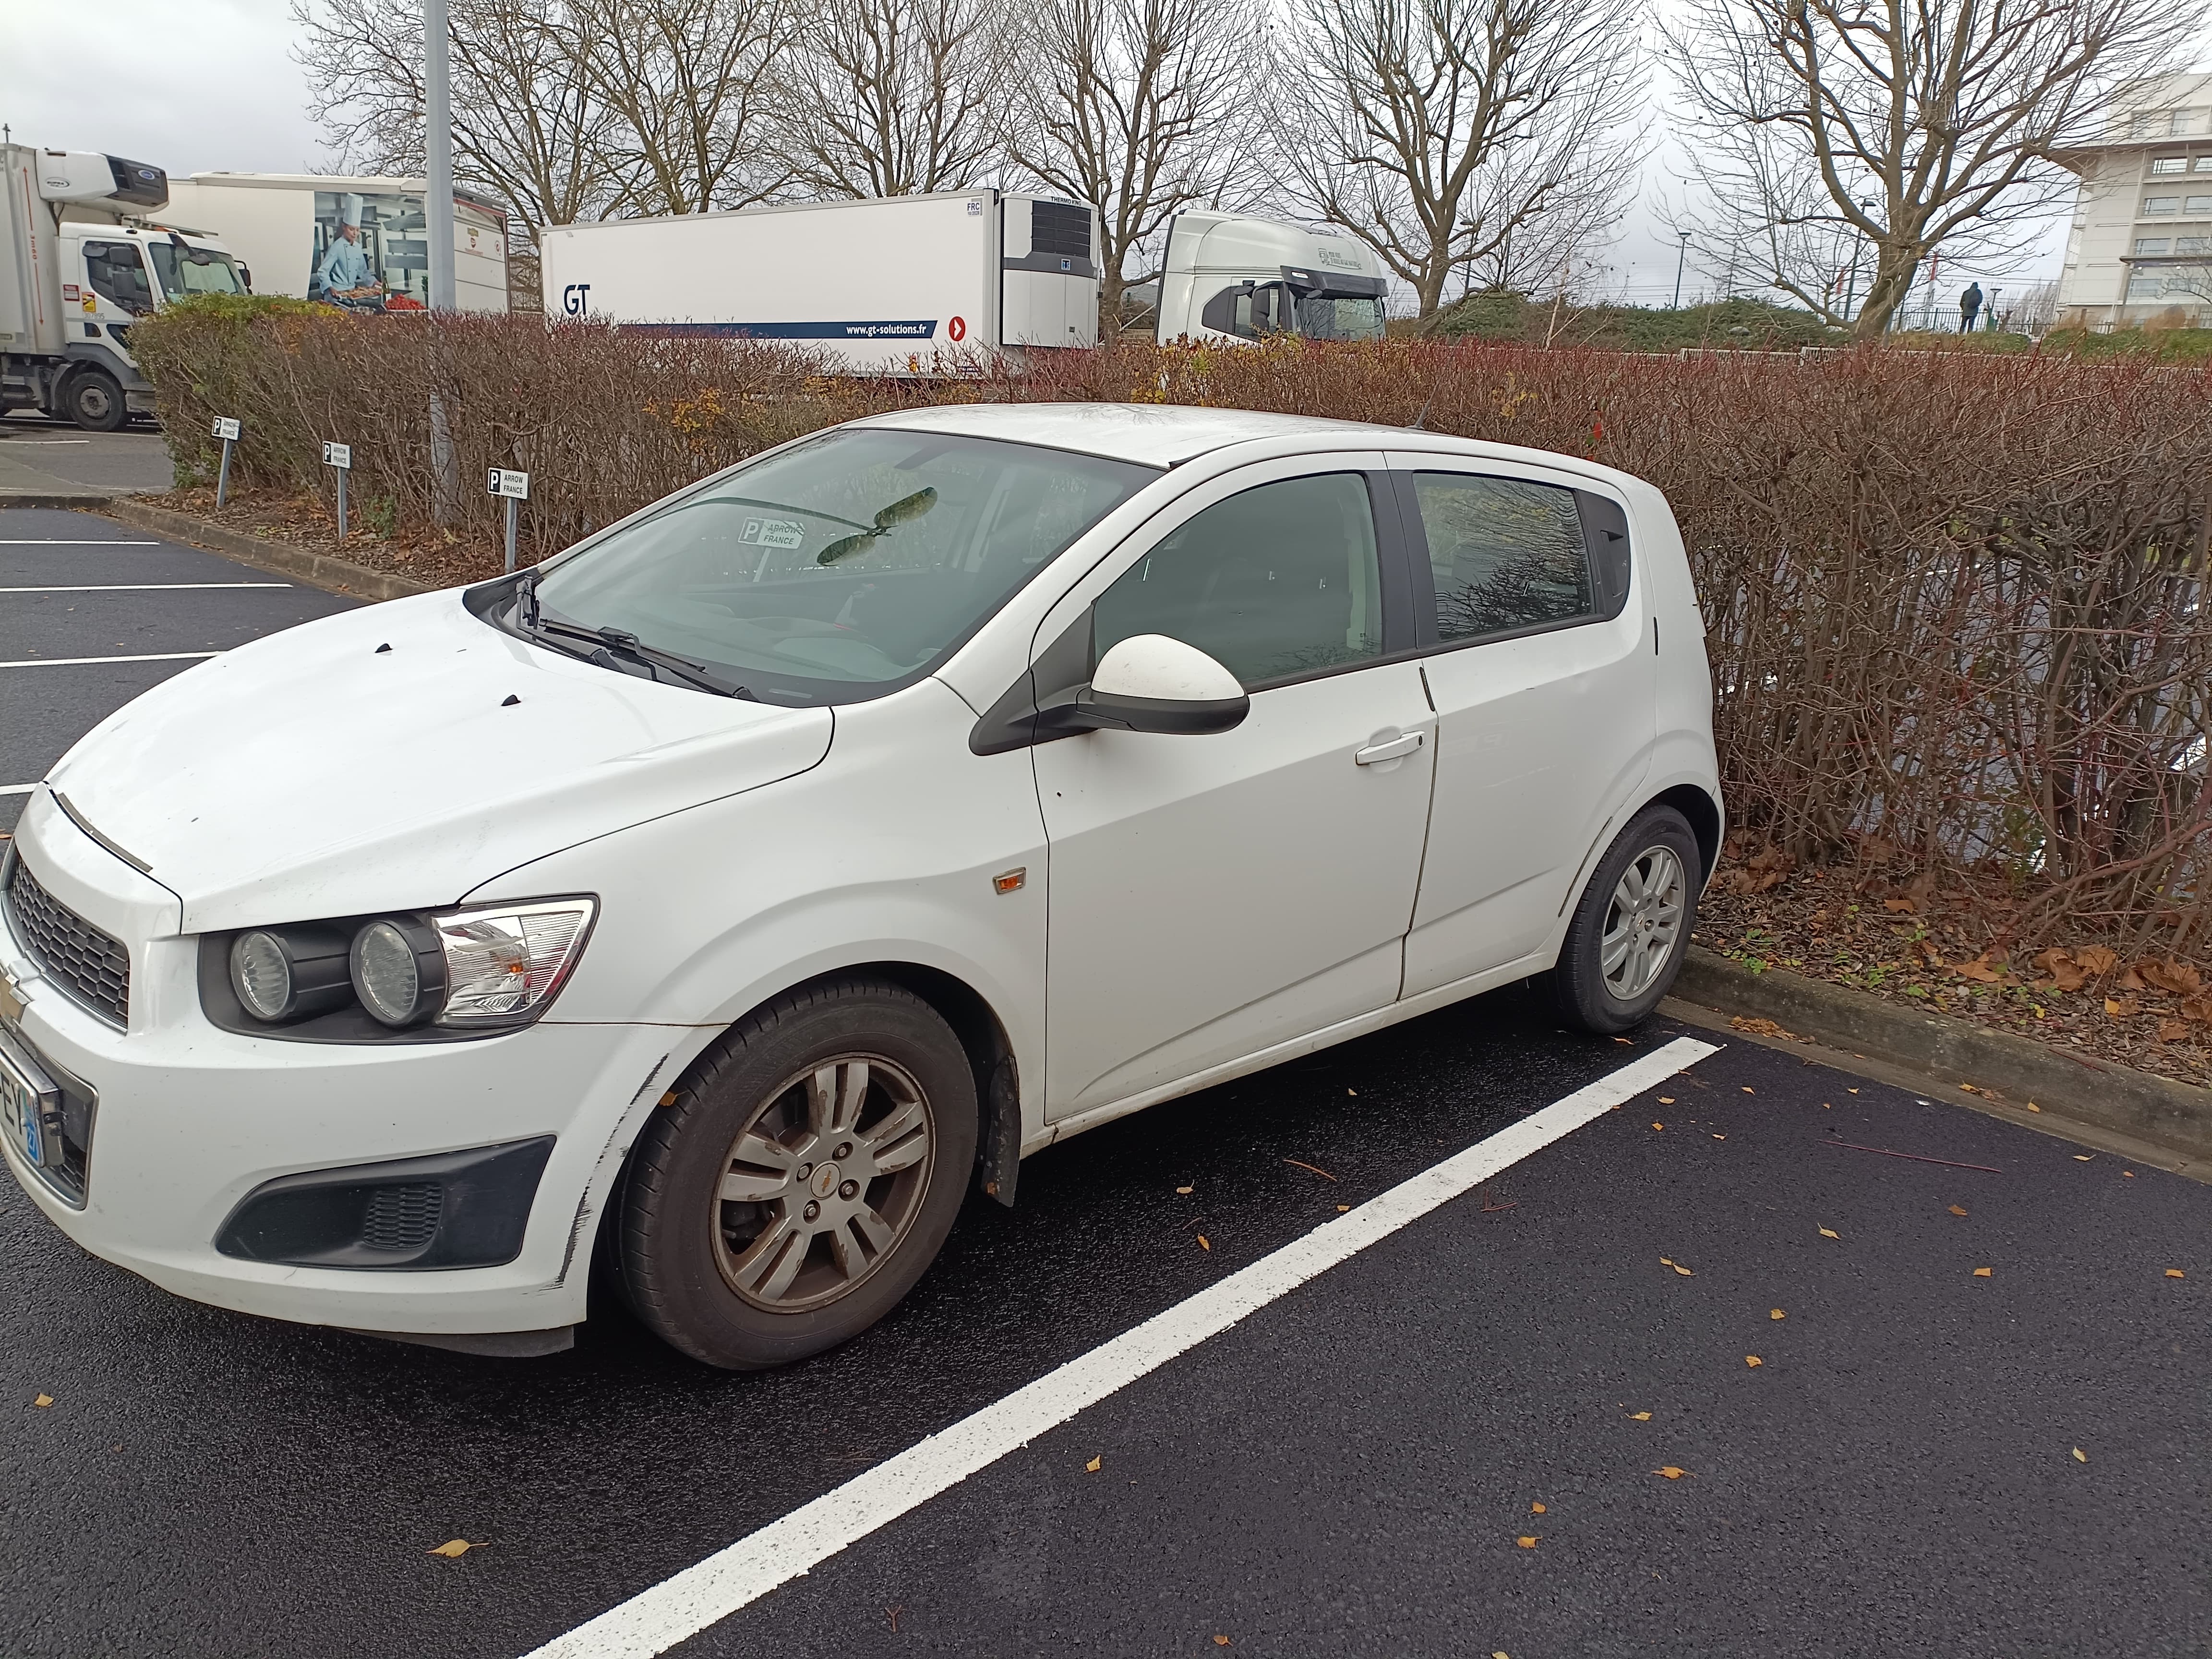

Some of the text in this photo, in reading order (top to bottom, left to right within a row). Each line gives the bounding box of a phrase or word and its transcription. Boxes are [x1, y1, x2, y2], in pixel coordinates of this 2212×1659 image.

[1050, 196, 1071, 204] THERMO
[967, 203, 980, 211] FRC
[564, 284, 590, 315] GT
[846, 324, 927, 337] www.gt-solutions.fr
[324, 445, 330, 460] P
[491, 472, 523, 490] P ARROW
[503, 485, 523, 494] FRANCE
[744, 521, 759, 539] P
[764, 535, 794, 544] FRANCE
